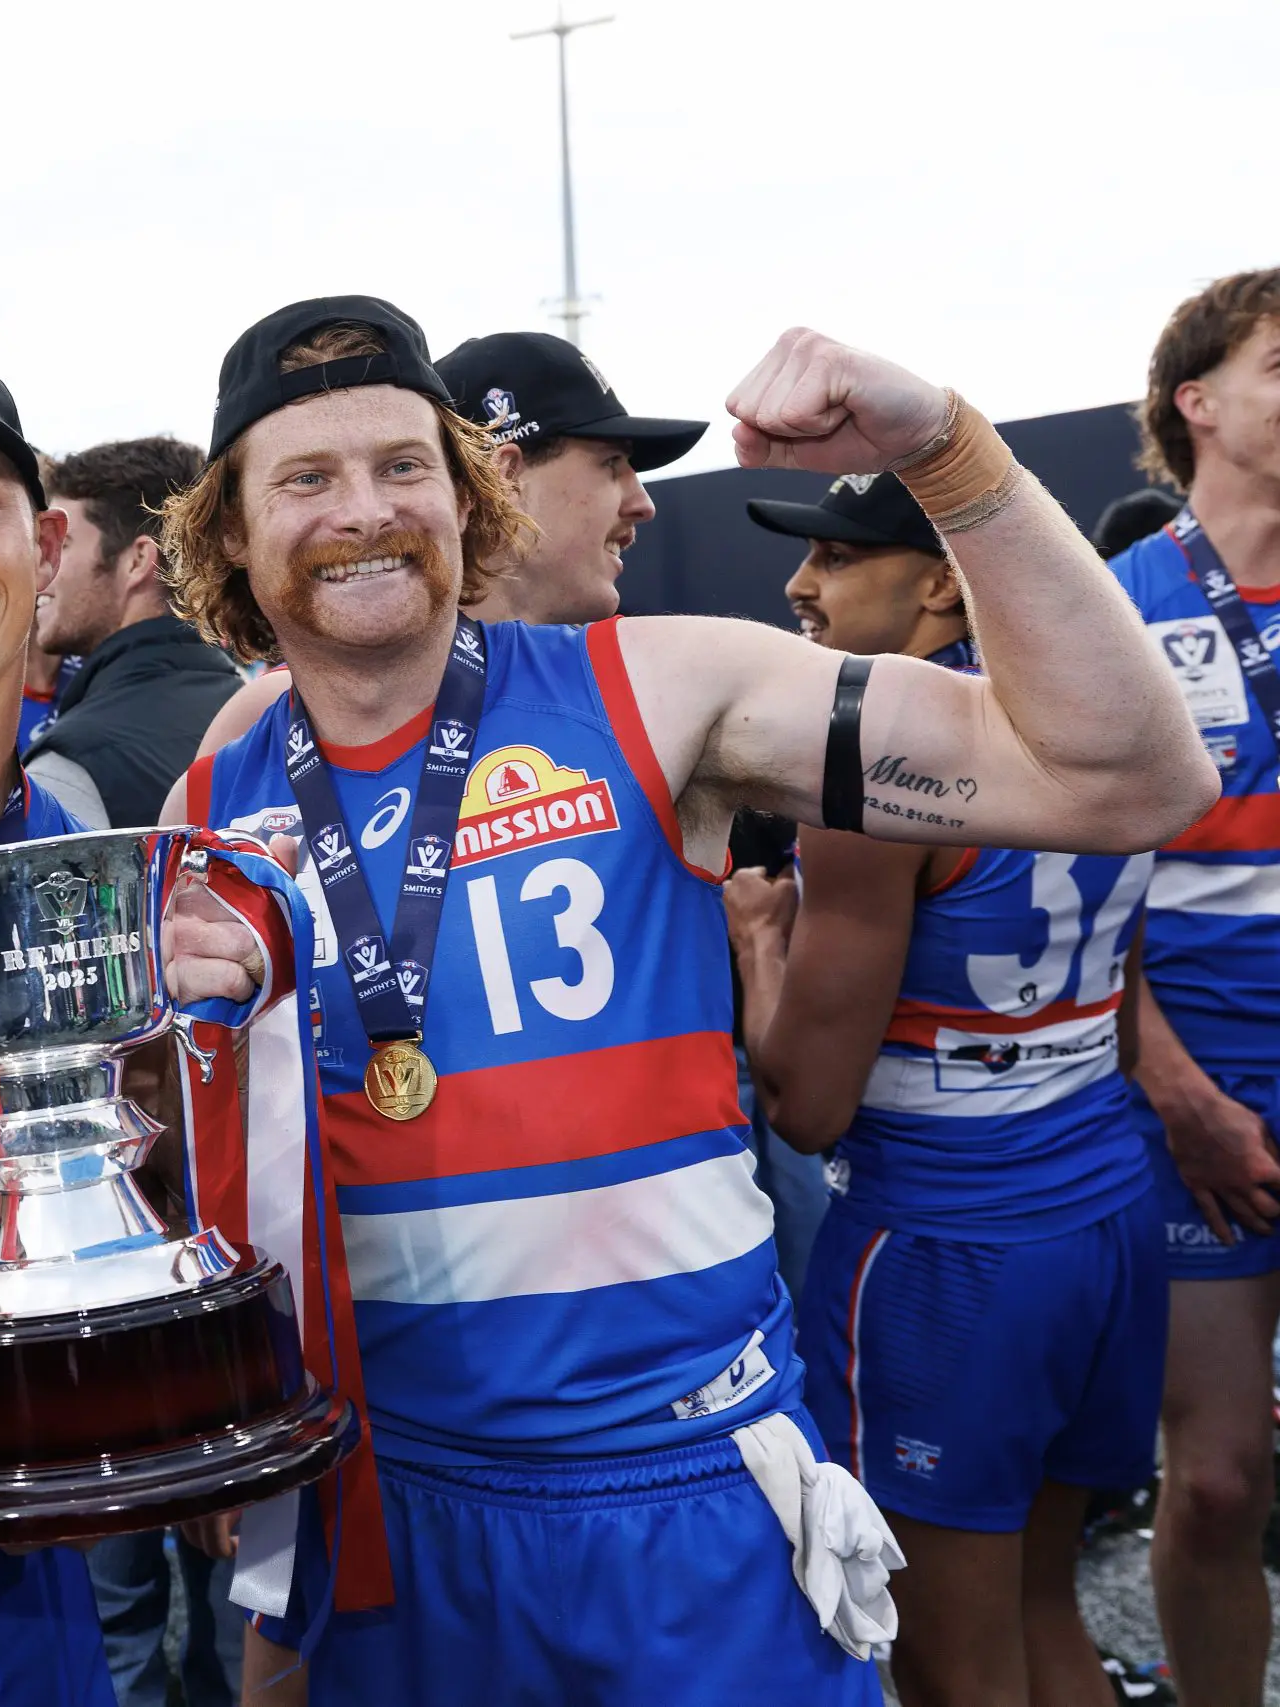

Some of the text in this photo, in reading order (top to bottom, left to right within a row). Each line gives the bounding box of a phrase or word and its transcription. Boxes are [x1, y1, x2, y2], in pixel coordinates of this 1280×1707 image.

[452, 652, 485, 675] SMITHY'S
[290, 756, 320, 781] SMITHY'S
[426, 763, 466, 775] SMITHY'S
[864, 755, 950, 798] Mum
[264, 816, 294, 829] AFL
[324, 862, 358, 886] SMITHY'S
[403, 884, 443, 895] SMITHY'S
[56, 918, 73, 927] VFL
[466, 857, 615, 1035] 13
[44, 966, 98, 991] 2025
[358, 978, 397, 999] SMITHY'S
